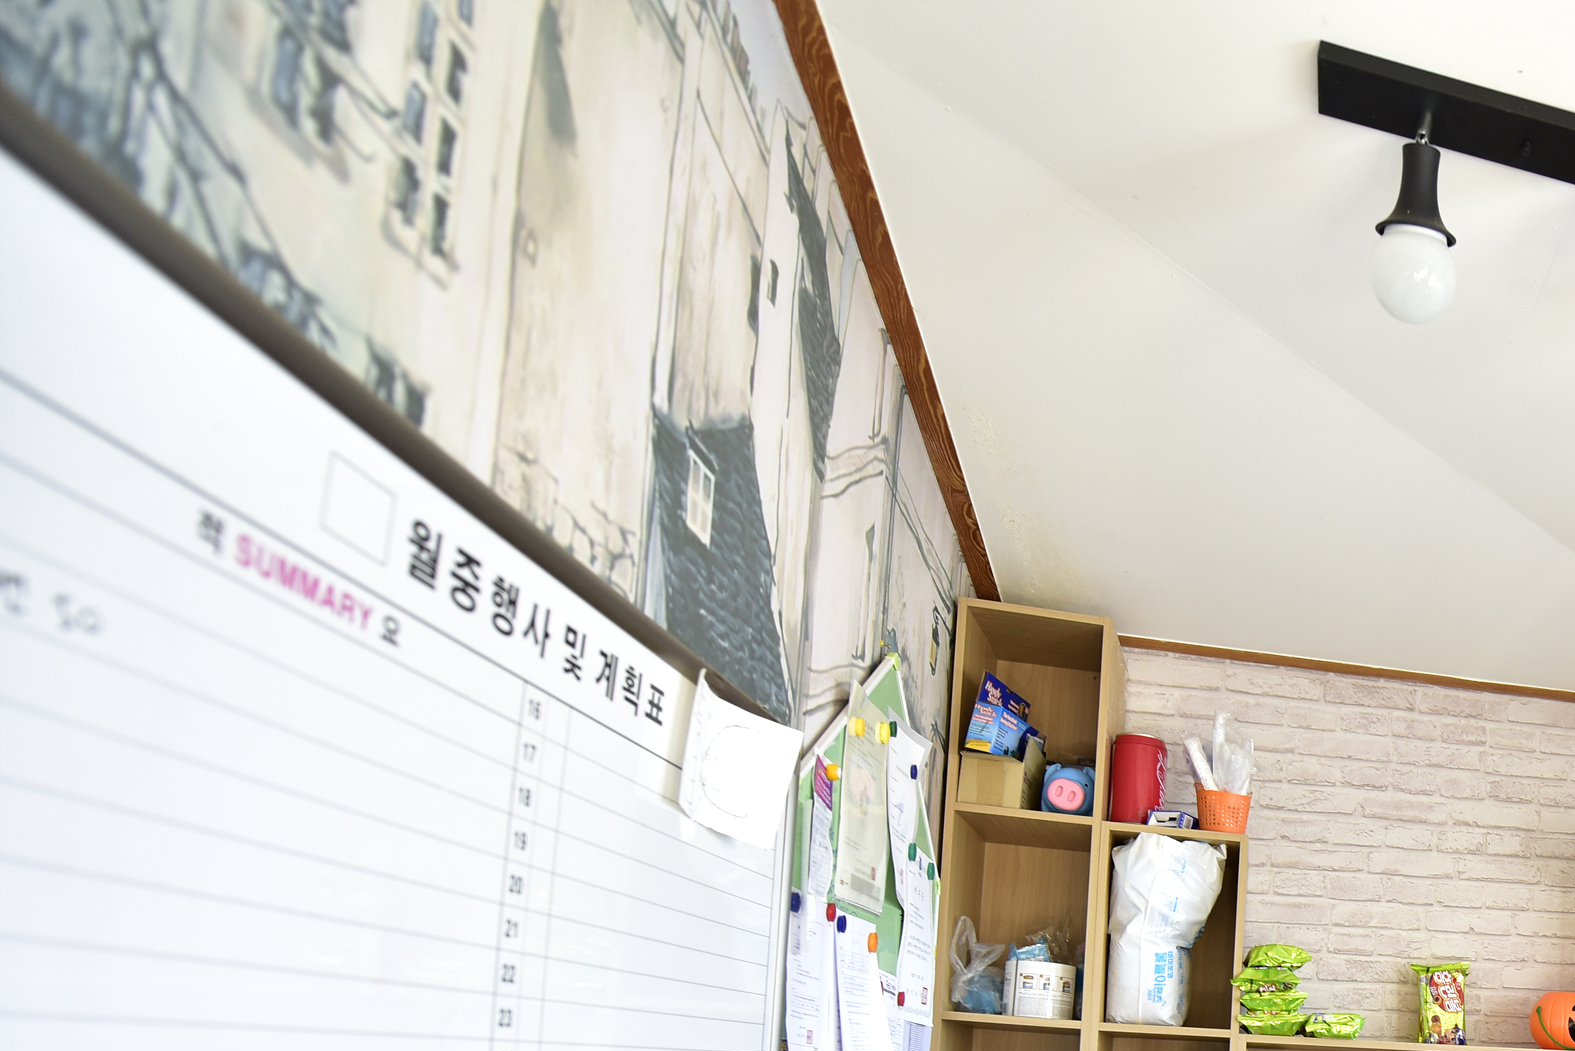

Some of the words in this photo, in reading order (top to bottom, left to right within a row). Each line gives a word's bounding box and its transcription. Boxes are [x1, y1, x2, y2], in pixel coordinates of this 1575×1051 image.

[234, 532, 375, 631] SUMMARY
[408, 519, 552, 659] 월중행사
[563, 625, 587, 682] 및
[595, 650, 666, 727] 계획표
[523, 742, 537, 763] 17
[518, 787, 532, 807] 18
[513, 831, 527, 851] 19
[509, 874, 524, 894] 20
[504, 919, 519, 938] 21
[501, 963, 516, 984] 22
[498, 1009, 512, 1027] 23
